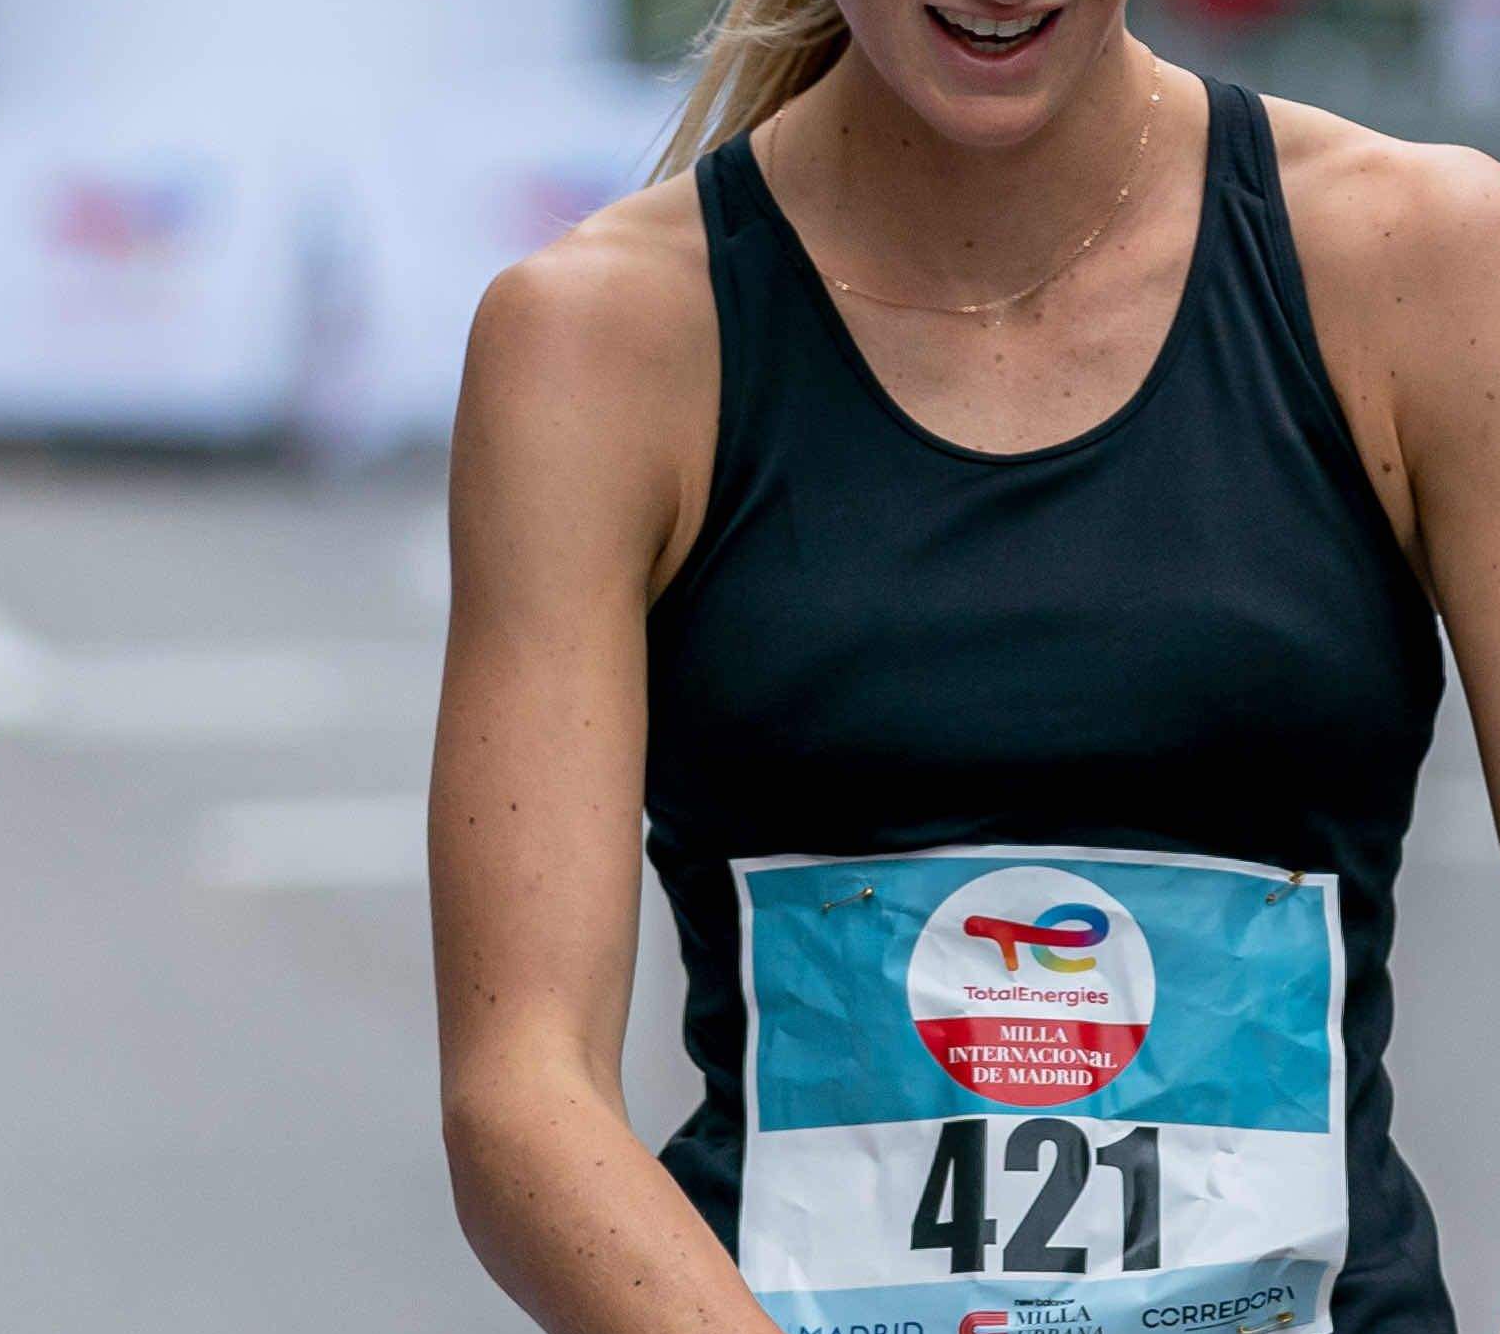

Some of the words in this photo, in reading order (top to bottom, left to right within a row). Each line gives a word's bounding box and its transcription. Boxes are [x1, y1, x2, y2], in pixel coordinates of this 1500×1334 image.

[963, 985, 1110, 1007] TotalEnergies
[1000, 1024, 1069, 1044] MILLA
[972, 1066, 1003, 1085] DE
[1007, 1067, 1094, 1087] MADRID
[910, 1117, 1162, 1275] 421
[1015, 1305, 1093, 1326] MILLA
